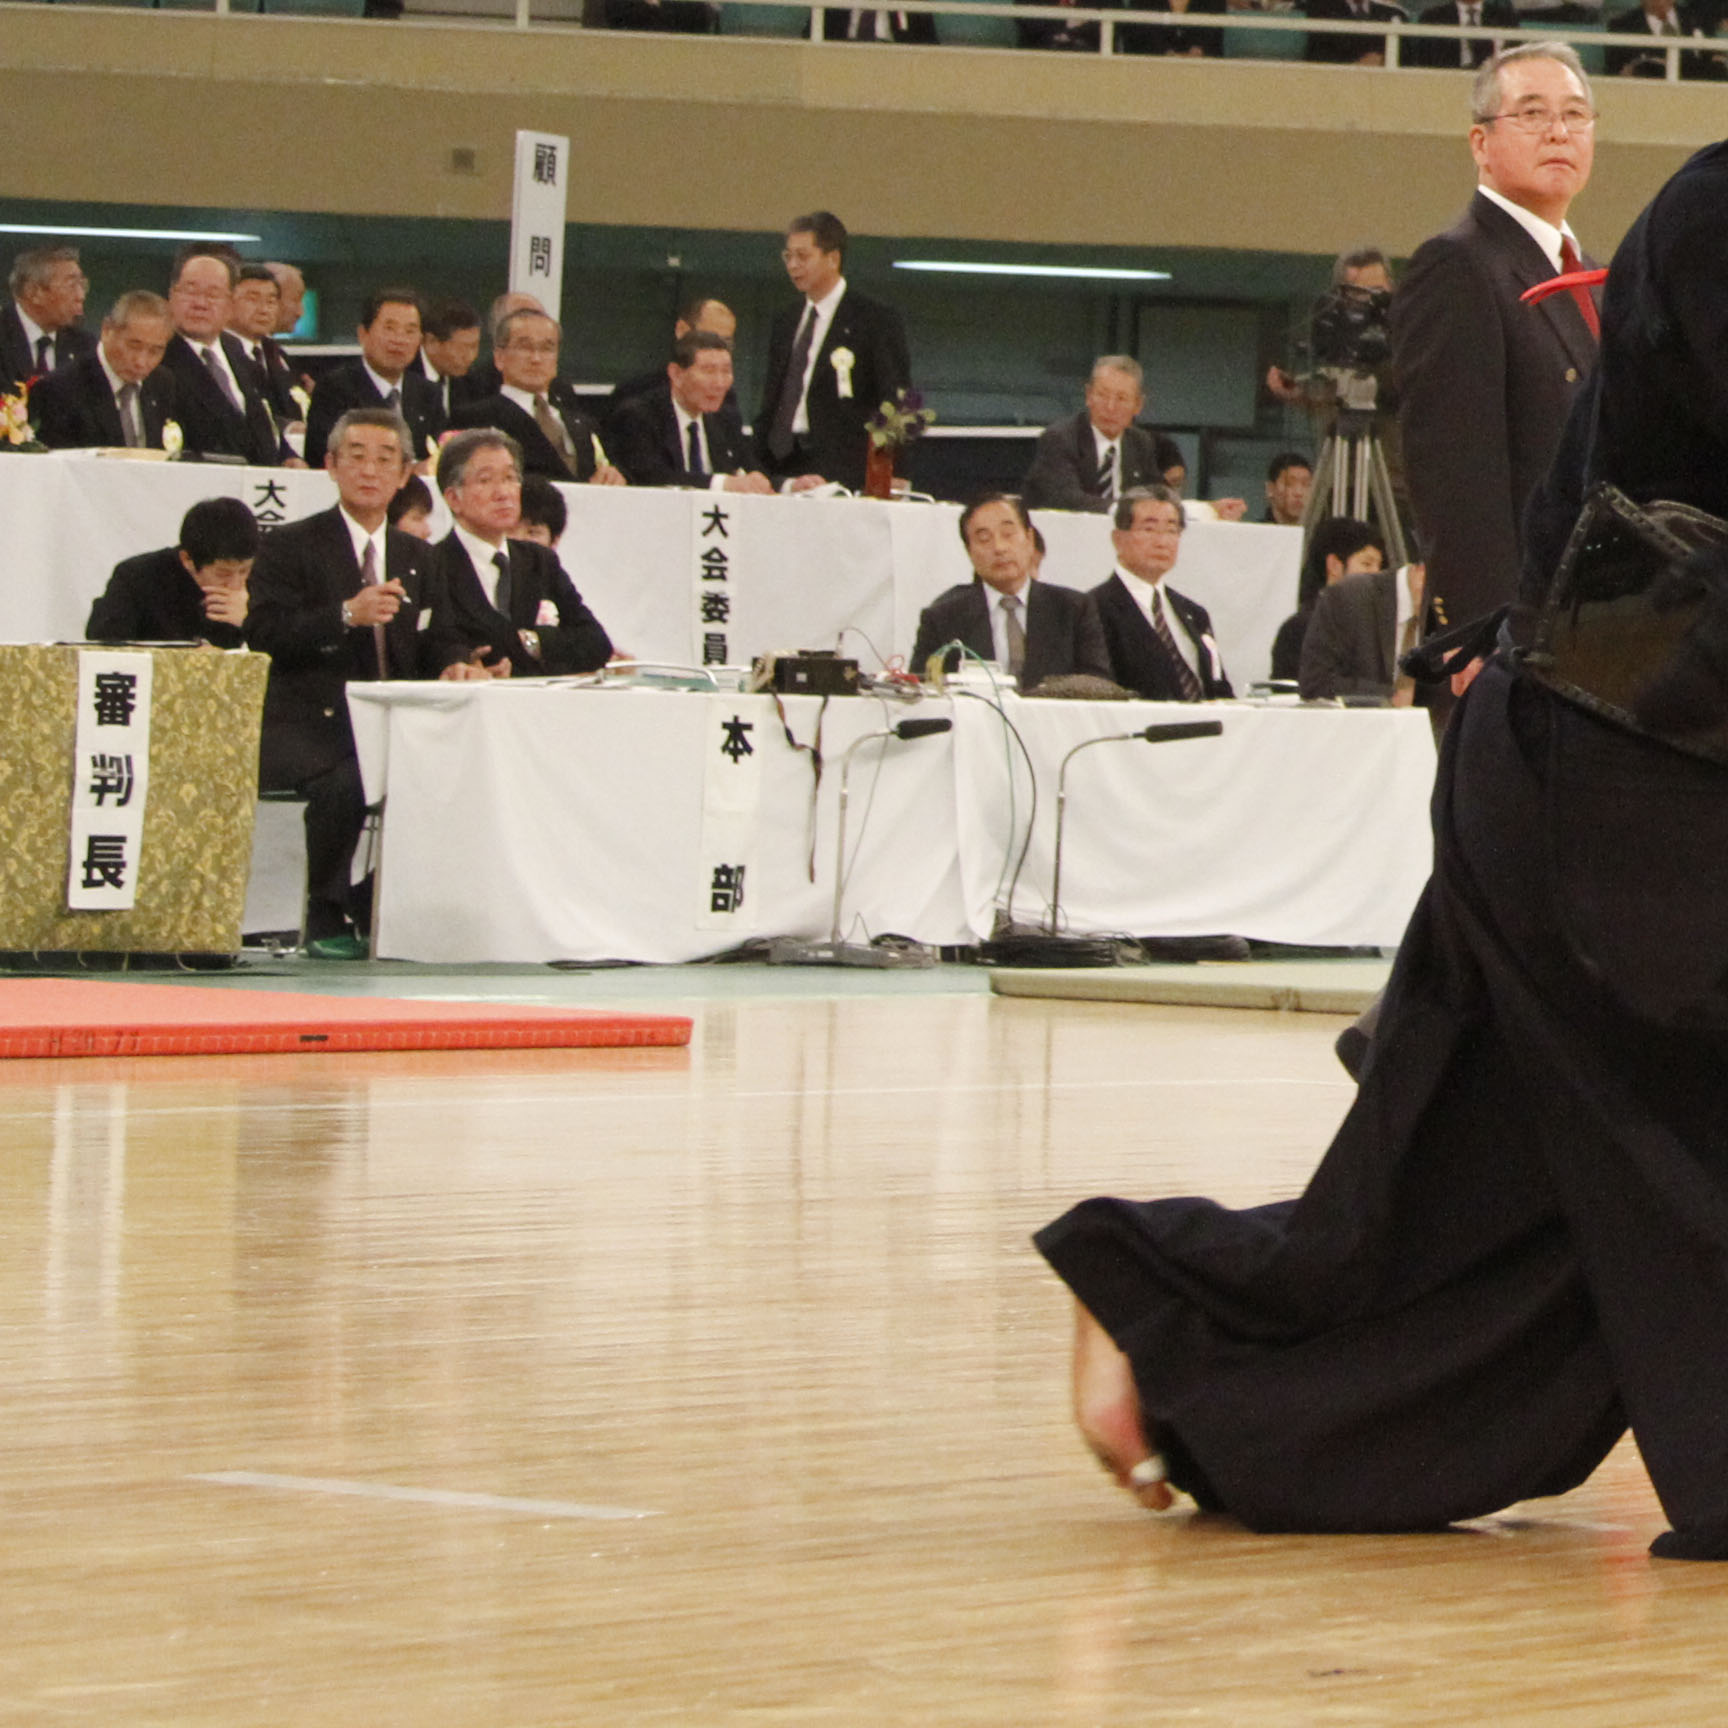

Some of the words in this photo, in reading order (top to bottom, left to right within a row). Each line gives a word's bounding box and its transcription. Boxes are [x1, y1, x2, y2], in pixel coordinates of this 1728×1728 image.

[529, 143, 557, 278] 顧問
[701, 504, 730, 665] 大会委員
[81, 671, 137, 889] 審判長
[710, 715, 753, 912] 本部
